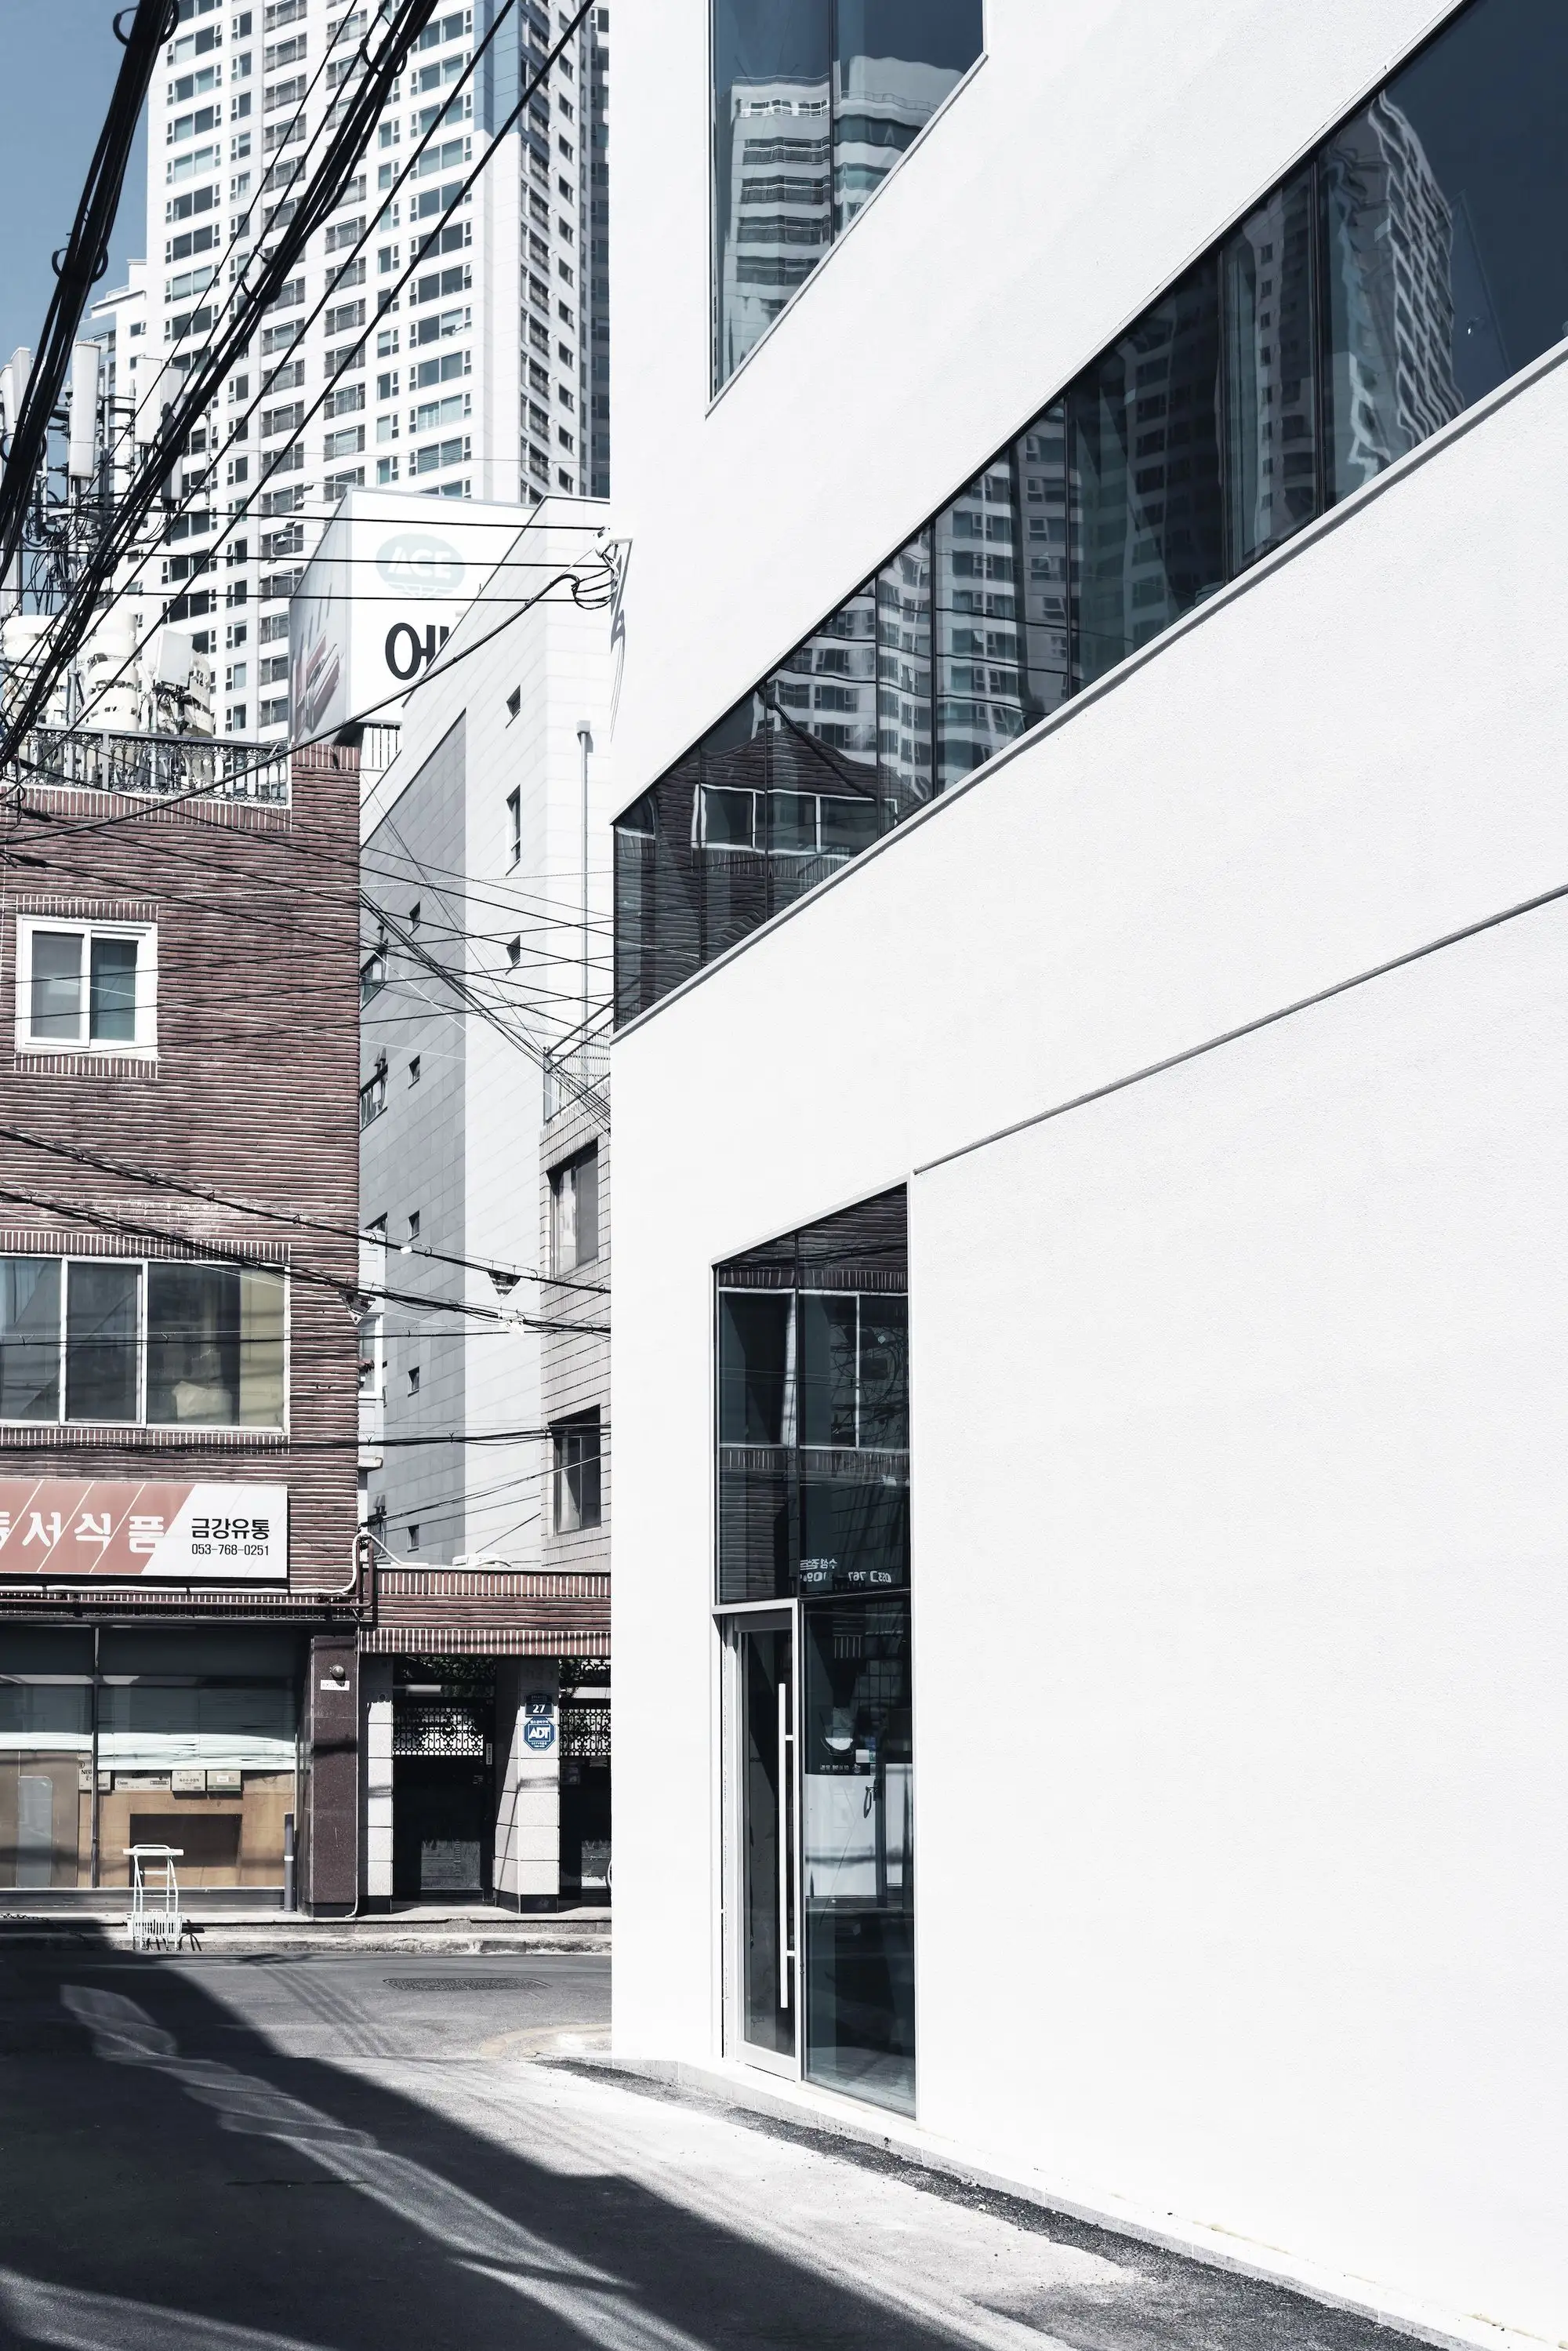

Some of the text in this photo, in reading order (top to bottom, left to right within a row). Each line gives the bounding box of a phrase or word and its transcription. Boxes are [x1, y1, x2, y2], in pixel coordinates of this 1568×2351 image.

[387, 546, 452, 580] ACE
[0, 1511, 165, 1553] 서식품
[191, 1518, 270, 1539] 금강유통
[191, 1543, 269, 1556] 053-768-0251
[532, 1704, 546, 1713] 27
[528, 1727, 550, 1739] ADT
